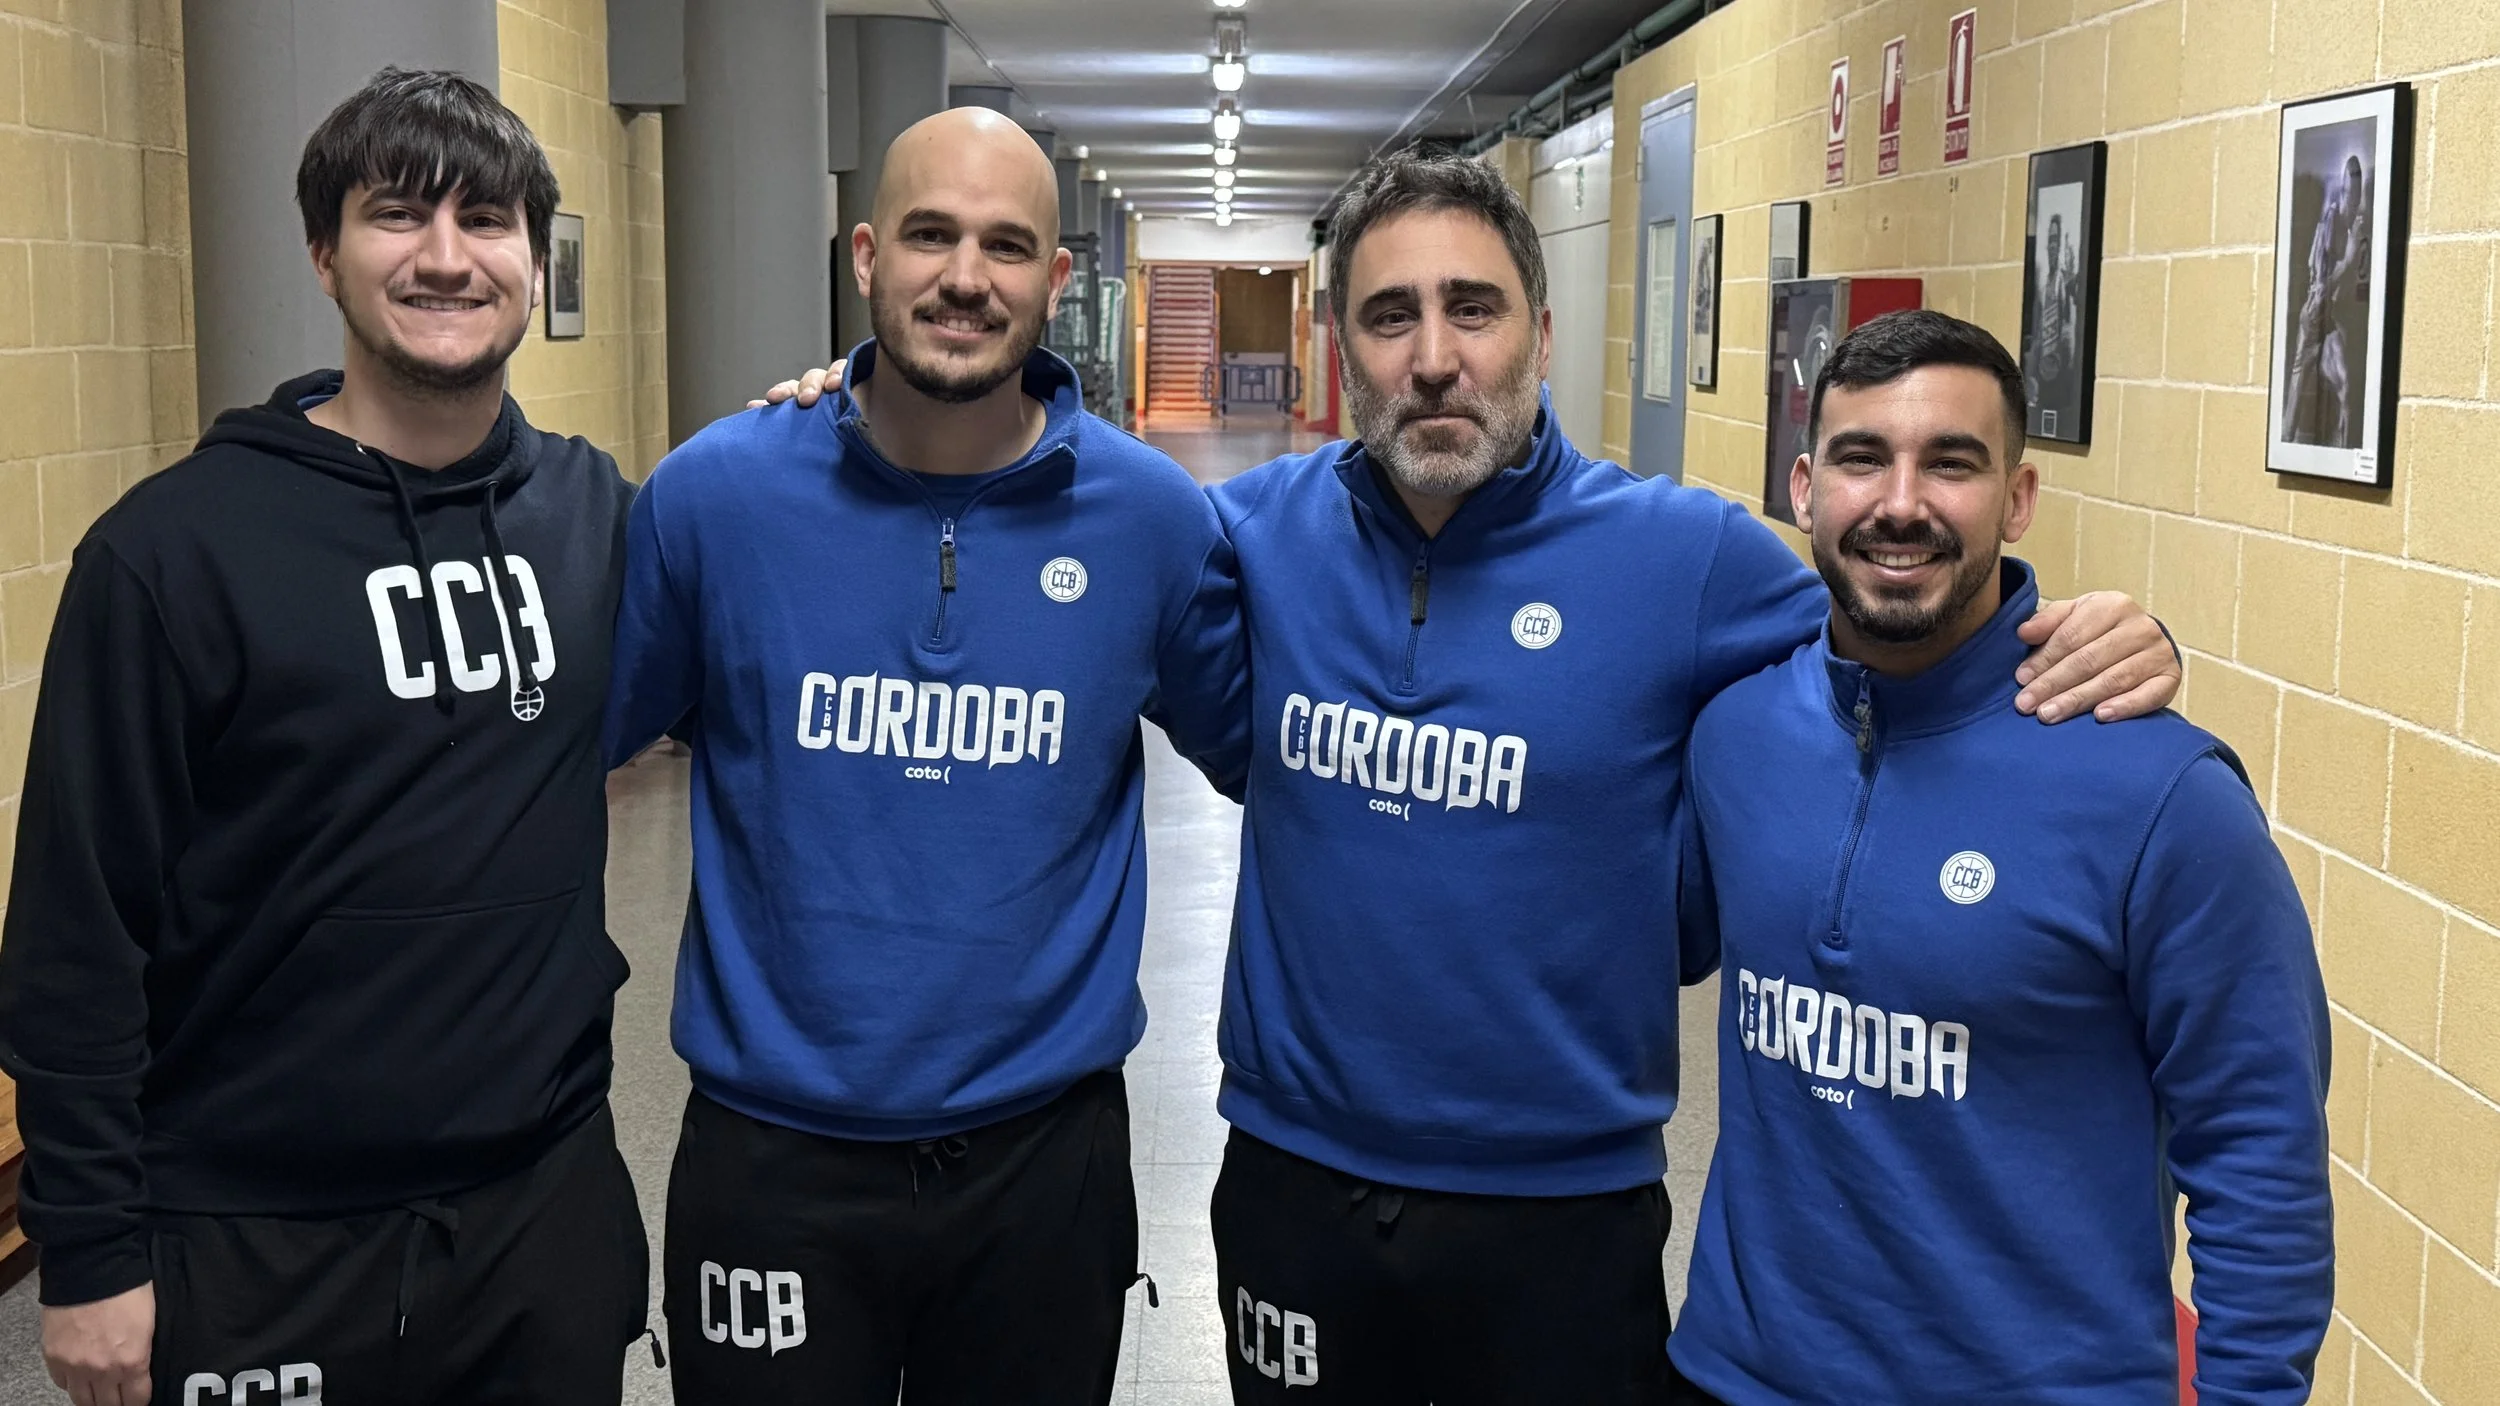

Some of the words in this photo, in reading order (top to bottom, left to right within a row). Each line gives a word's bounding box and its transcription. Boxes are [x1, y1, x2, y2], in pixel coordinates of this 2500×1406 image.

[1051, 570, 1078, 589] CCB
[1522, 616, 1551, 636] CCB
[1952, 866, 1983, 889] CCB
[700, 1260, 806, 1358] CCB
[1237, 1285, 1319, 1389] CCB
